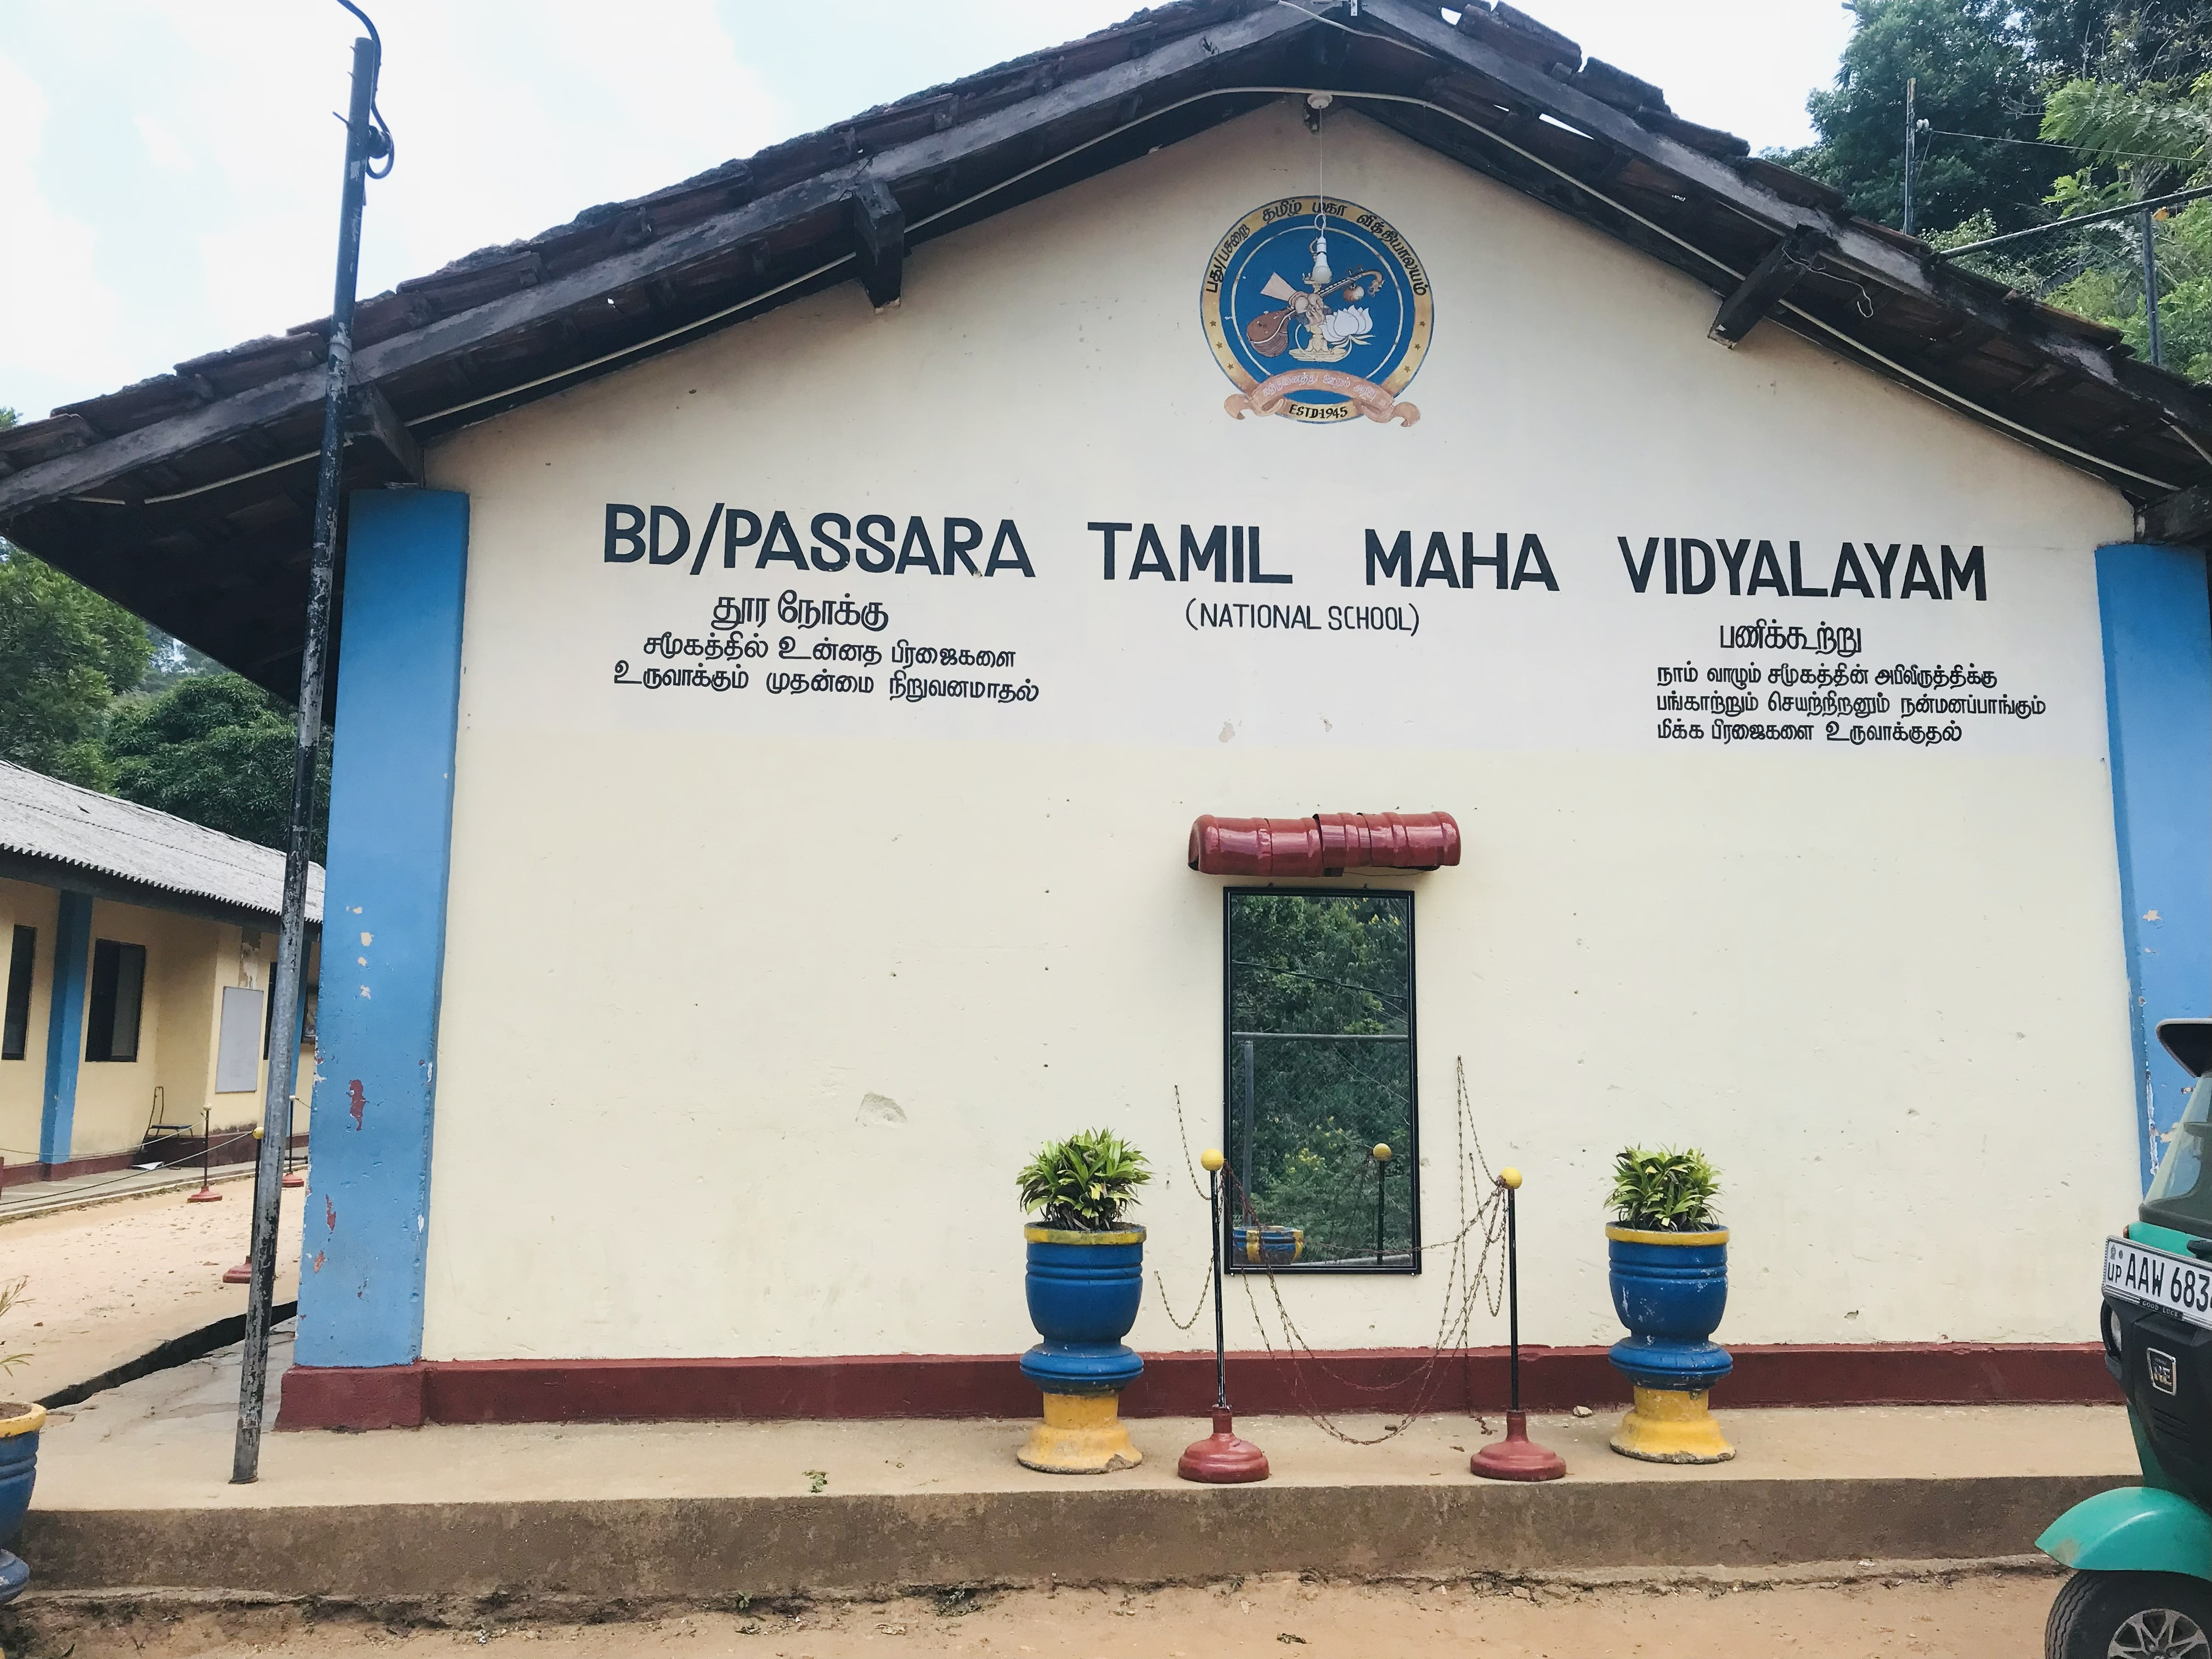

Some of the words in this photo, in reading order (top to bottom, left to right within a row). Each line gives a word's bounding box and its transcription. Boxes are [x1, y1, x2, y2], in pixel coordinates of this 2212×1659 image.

[1206, 224, 1250, 293] பது/பசறை
[1262, 200, 1302, 224] தமிழ்
[1312, 201, 1347, 217] மகா
[605, 503, 1036, 578] BD/PASSARA
[1087, 522, 1293, 584] TAMIL
[1365, 528, 1560, 591] MAHA
[1617, 536, 1987, 601] VIDYALAYAM
[710, 597, 770, 631] தூர
[777, 589, 889, 632] நோக்கு
[1186, 597, 1322, 631] (NATIONAL
[1328, 603, 1419, 637] SCHOOL)
[643, 631, 769, 662] சமூகத்தில்
[778, 636, 882, 668] உன்னத
[891, 639, 1016, 670] பிரஜைகளை
[1720, 618, 1862, 658] பணிக்கூற்று
[614, 660, 749, 692] உருவாக்கும்
[766, 668, 874, 695] முதன்மை
[889, 669, 1039, 703] நிறுவனமாதல்
[1657, 660, 1699, 687] நாம்
[1707, 661, 1762, 691] வாழும்
[1768, 662, 1869, 689] சமூகத்தின்
[1874, 663, 1997, 690] அபிவிருத்திக்கு
[1657, 690, 1759, 718] பங்காற்றும்
[1768, 690, 1890, 719] செயற்றிறனும்
[1900, 693, 2046, 720] நன்மனப்பாங்கும்
[1657, 718, 1705, 740] மிக்க
[1711, 718, 1814, 745] பிரஜைகளை
[1825, 720, 1962, 747] உருவாக்குதல்
[2107, 1262, 2122, 1283] UP
[2125, 1253, 2165, 1297] AAW
[2170, 1267, 2212, 1313] 683
[2142, 1300, 2159, 1311] GOOD
[2163, 1307, 2179, 1318] LUCK
